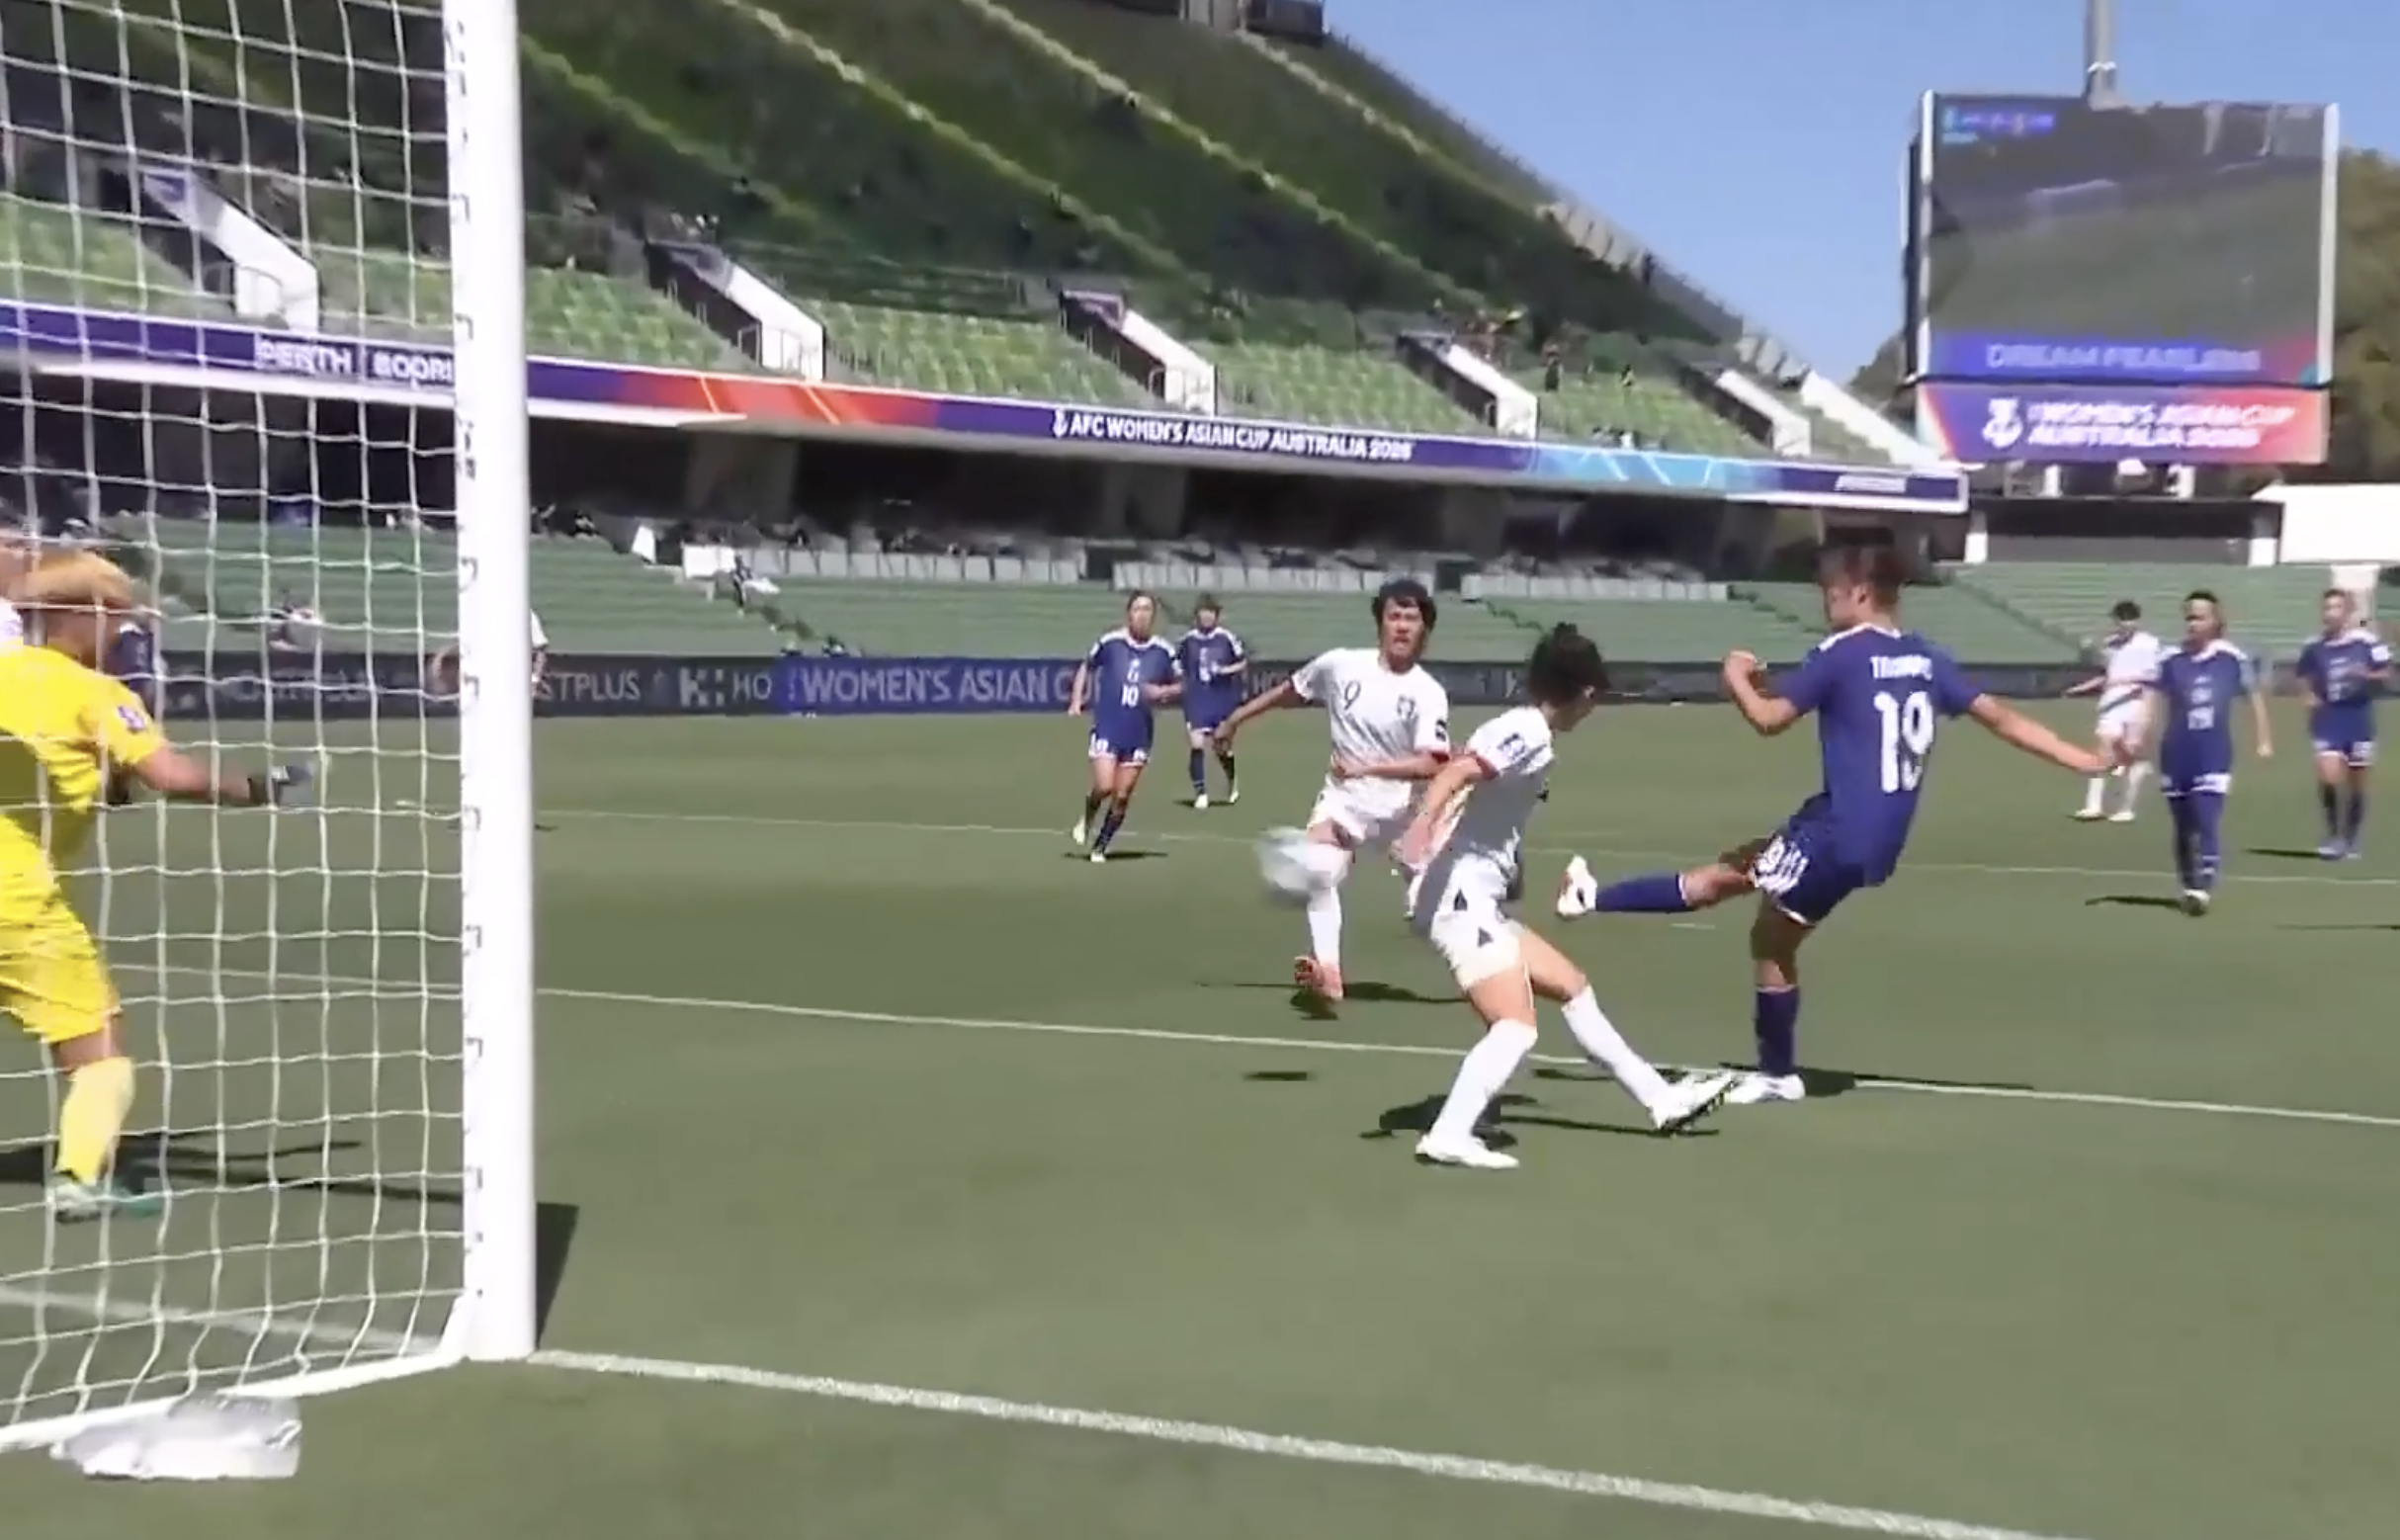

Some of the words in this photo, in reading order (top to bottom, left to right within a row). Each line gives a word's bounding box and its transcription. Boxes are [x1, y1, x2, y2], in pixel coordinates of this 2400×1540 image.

[255, 341, 352, 375] PERTH
[1071, 411, 1104, 438] AFC
[1106, 417, 1183, 444] WOMEN'S
[1186, 422, 1235, 447] ASIAN
[1236, 426, 1269, 451] CUP
[1270, 429, 1366, 459] AUSTRALIA
[801, 665, 952, 704] WOMEN'S
[957, 666, 1049, 704] ASIAN
[1121, 683, 1139, 708] 10
[1344, 680, 1361, 711] 9
[1874, 691, 1933, 793] 19
